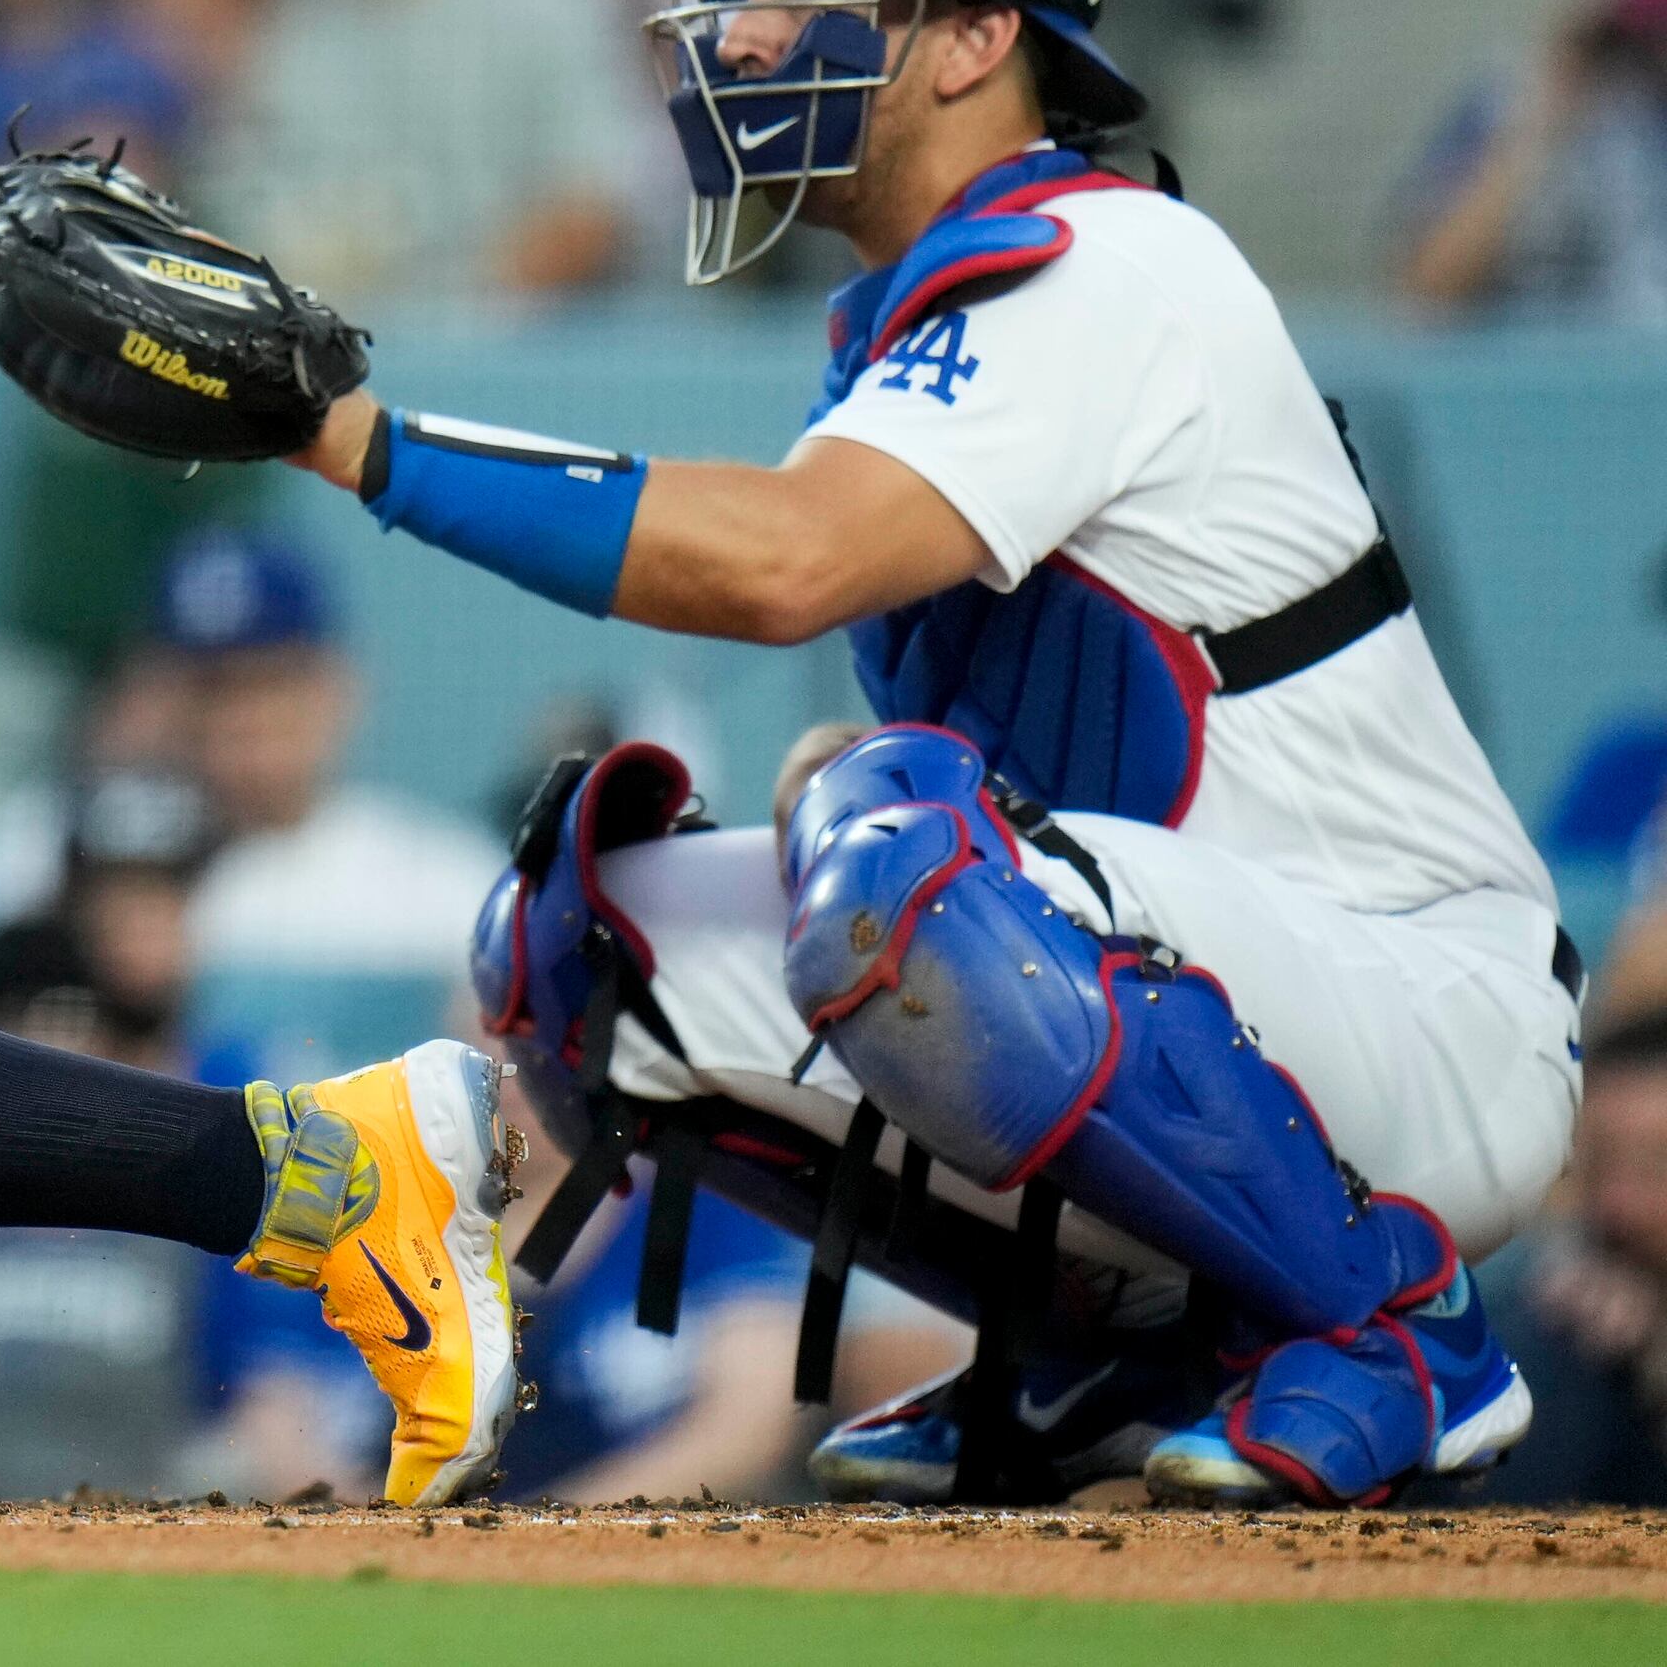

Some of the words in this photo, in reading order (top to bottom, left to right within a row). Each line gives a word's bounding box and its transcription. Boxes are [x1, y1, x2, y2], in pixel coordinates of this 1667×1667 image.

[146, 257, 243, 293] A2000
[120, 329, 231, 401] Wilson
[879, 308, 981, 408] LA
